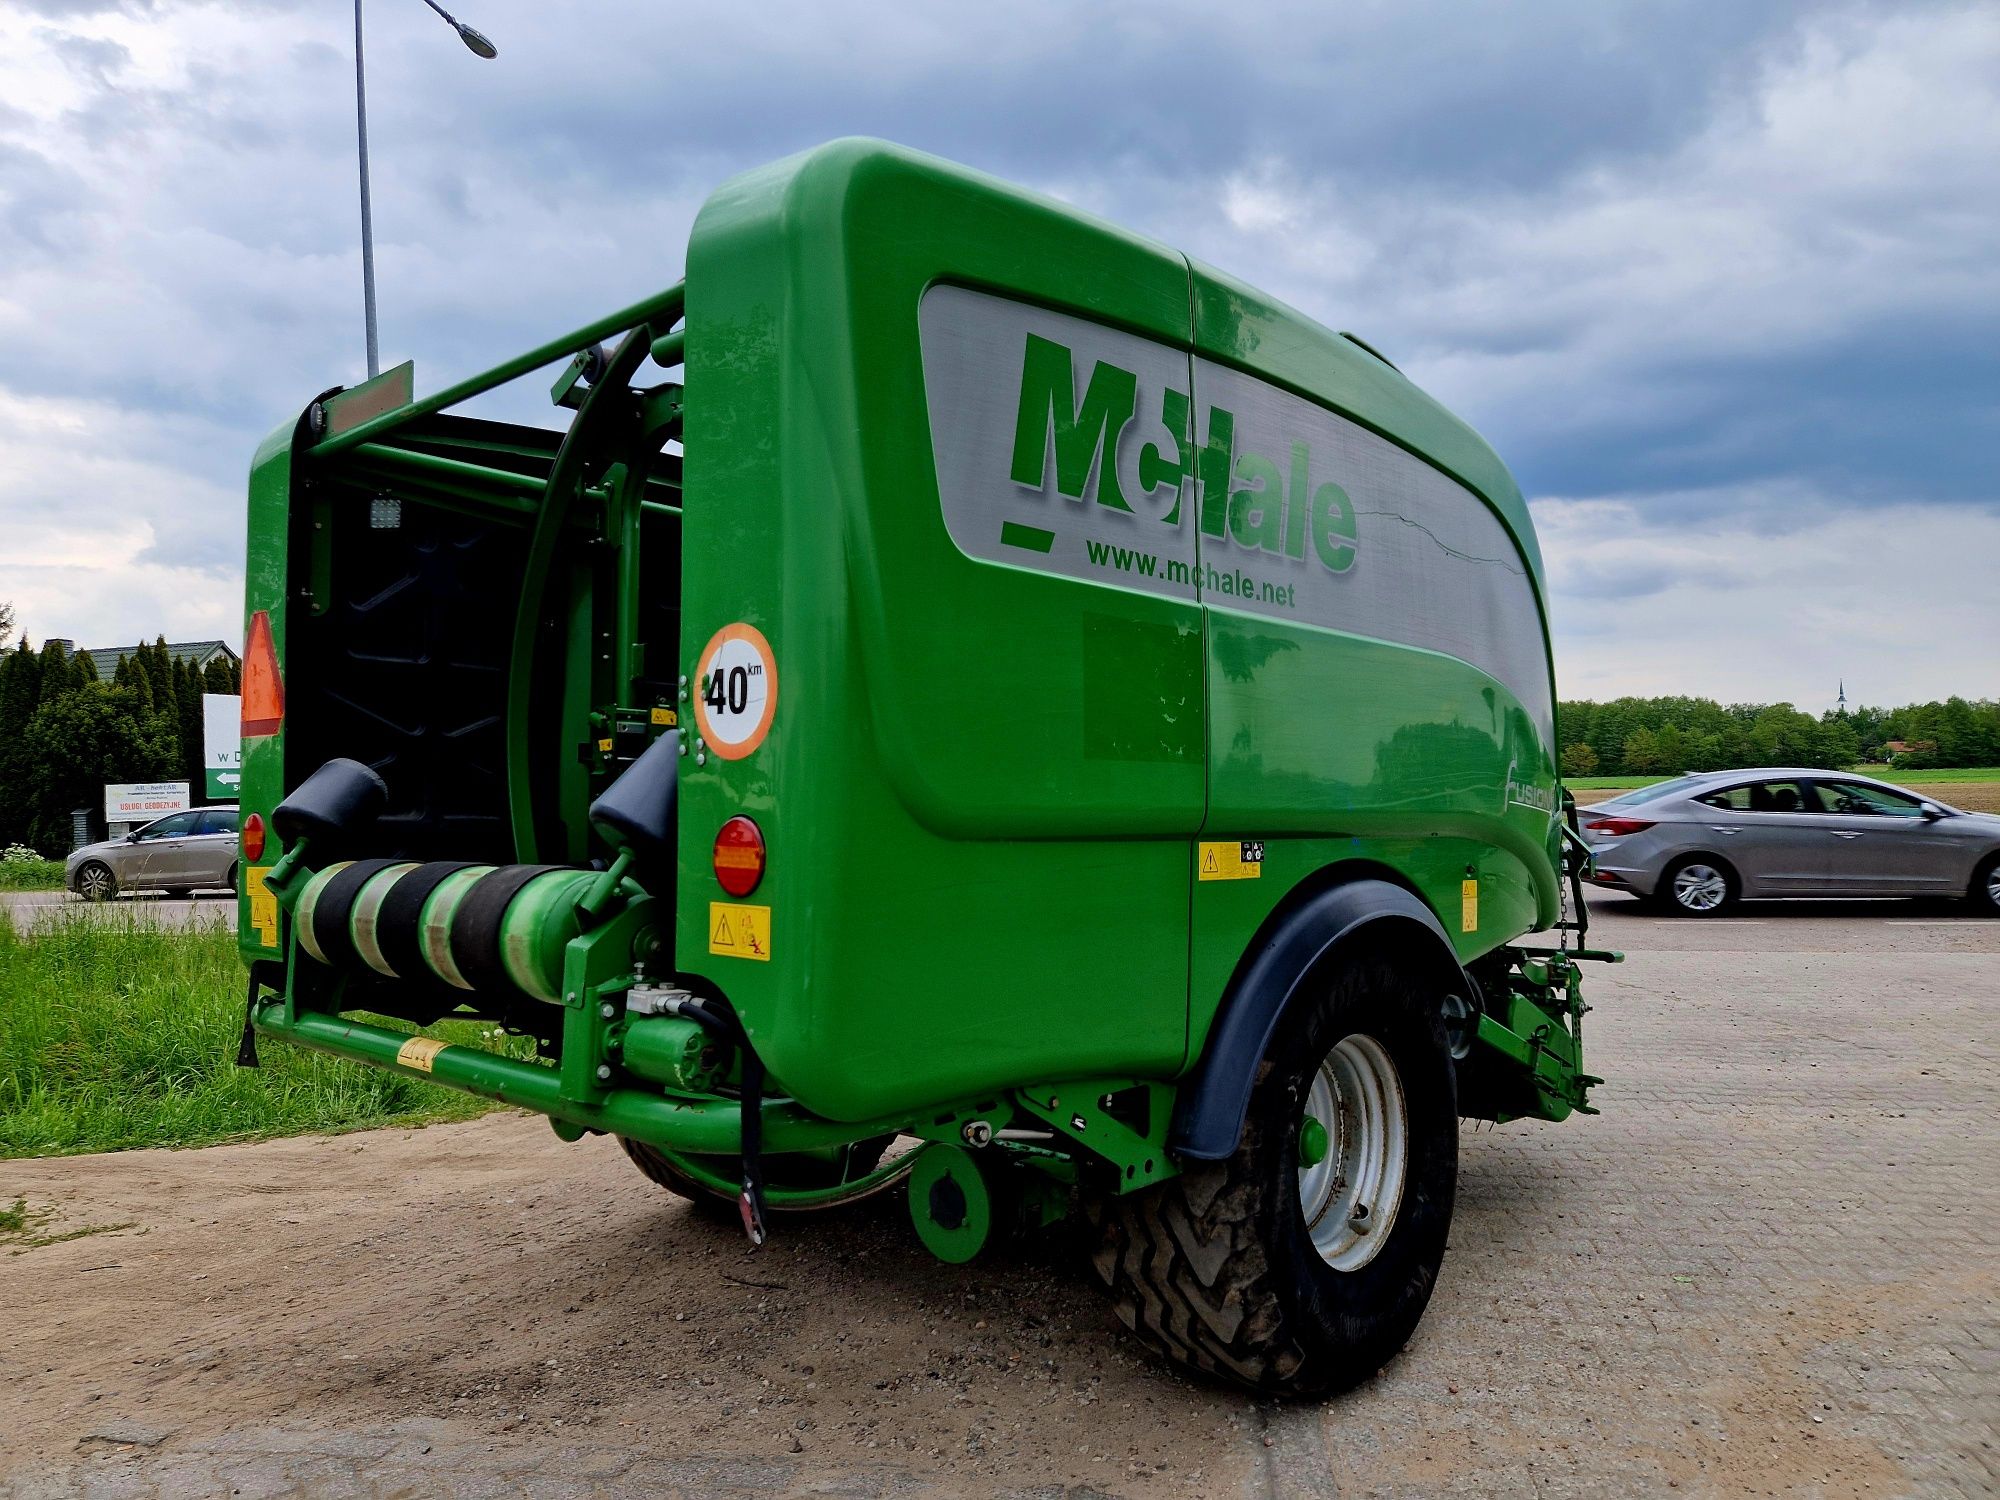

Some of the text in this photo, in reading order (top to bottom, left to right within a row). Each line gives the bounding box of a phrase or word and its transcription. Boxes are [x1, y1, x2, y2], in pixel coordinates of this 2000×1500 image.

[1010, 332, 1357, 573] McHale
[1086, 539, 1296, 608] www.mchale.net
[704, 663, 762, 714] 40 km
[144, 801, 181, 810] GEODEZYJNE
